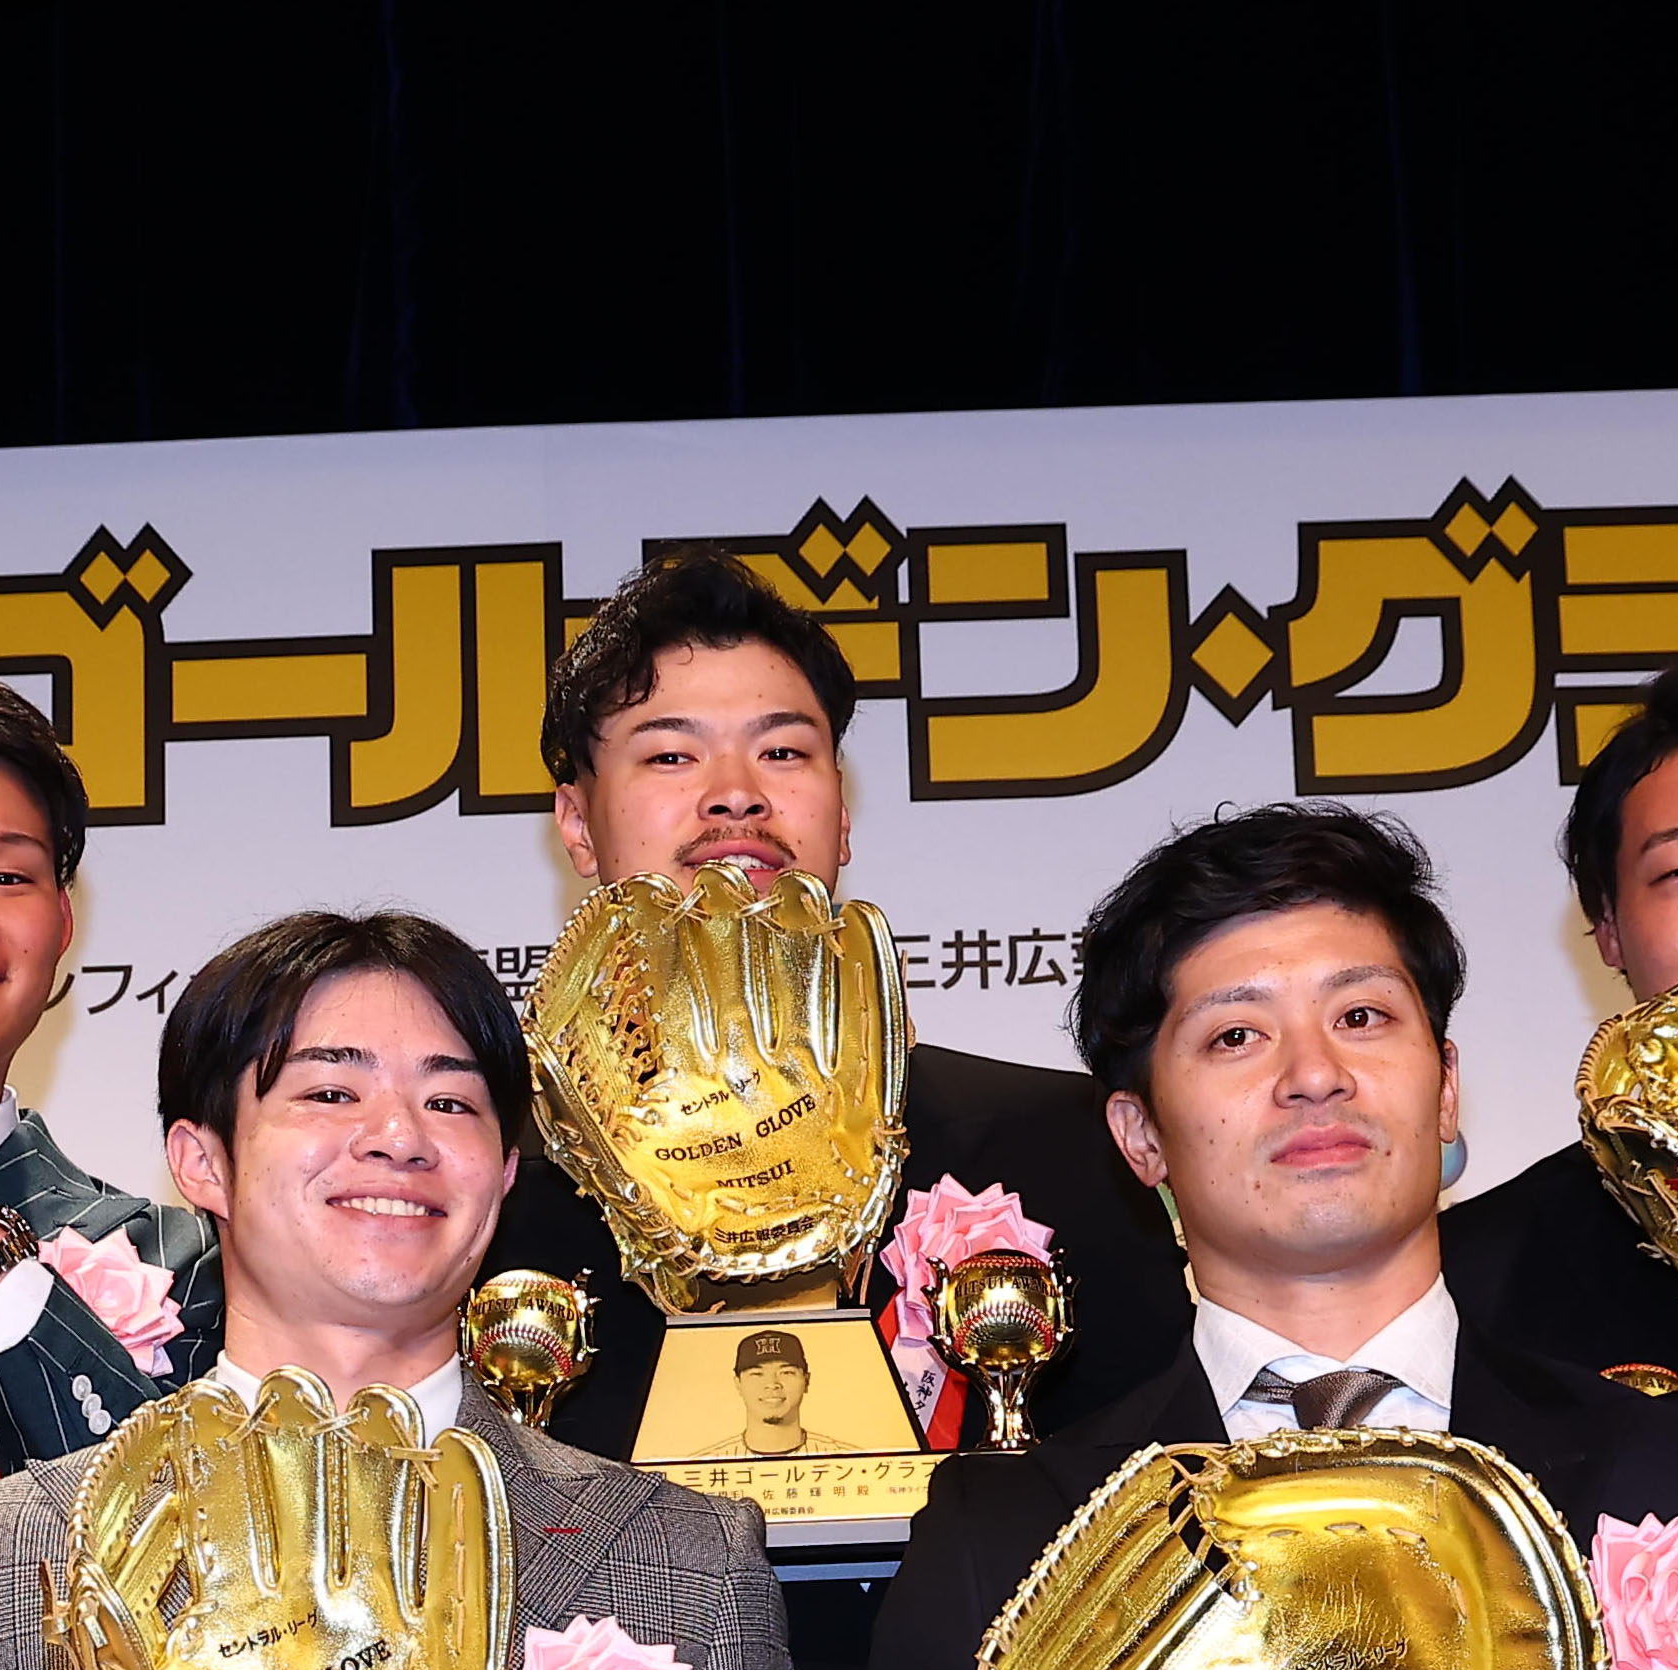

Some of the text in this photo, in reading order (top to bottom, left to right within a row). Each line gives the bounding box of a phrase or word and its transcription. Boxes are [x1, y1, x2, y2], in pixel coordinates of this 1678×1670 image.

[680, 1068, 761, 1115] セントラル・リーグ
[655, 1094, 816, 1161] GOLDEN GLOVE
[715, 1159, 796, 1189] MITSUI
[525, 1298, 575, 1321] AWARD
[217, 1608, 321, 1659] セントラル・リーグ
